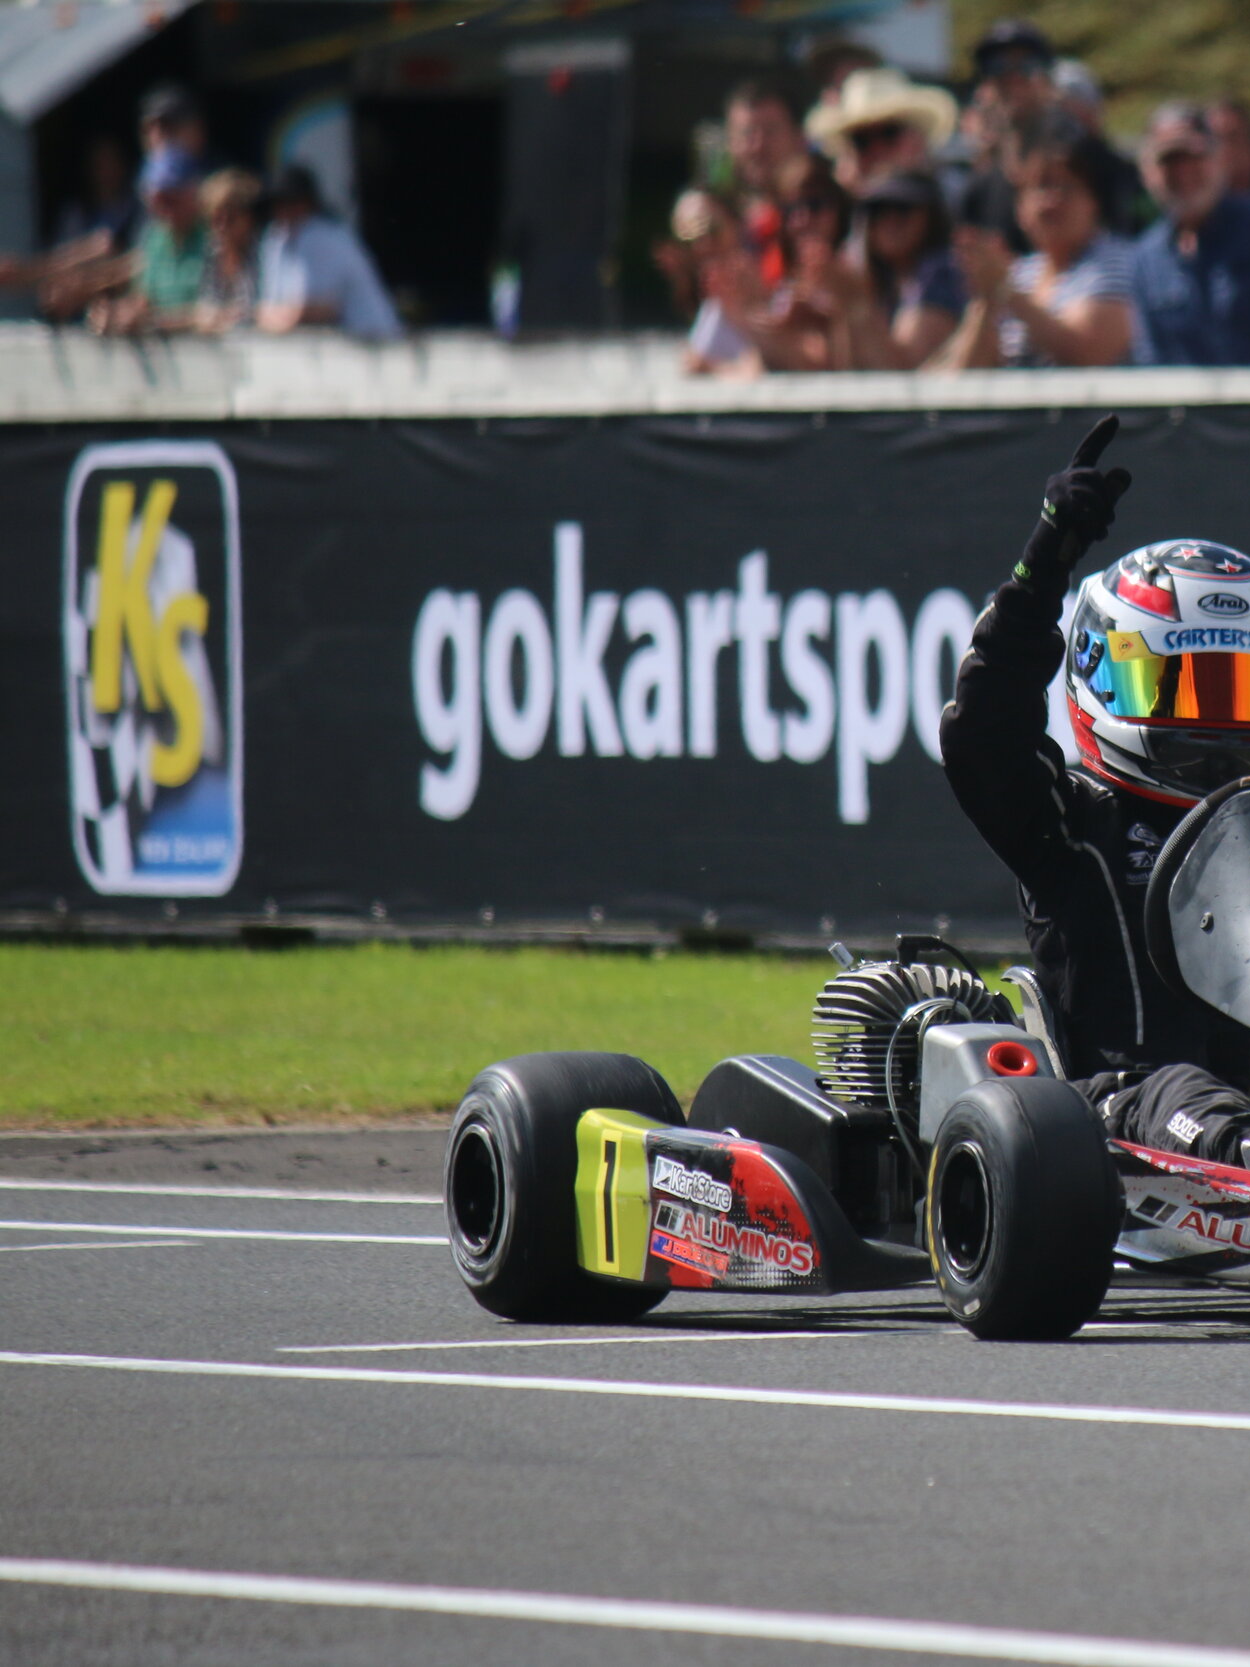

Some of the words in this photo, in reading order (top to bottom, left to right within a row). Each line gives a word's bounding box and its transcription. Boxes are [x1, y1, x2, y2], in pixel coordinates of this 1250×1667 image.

[1204, 593, 1244, 610] Arai
[603, 1140, 617, 1262] 1
[670, 1165, 732, 1211] KartStore
[681, 1212, 812, 1273] ALUMINOS
